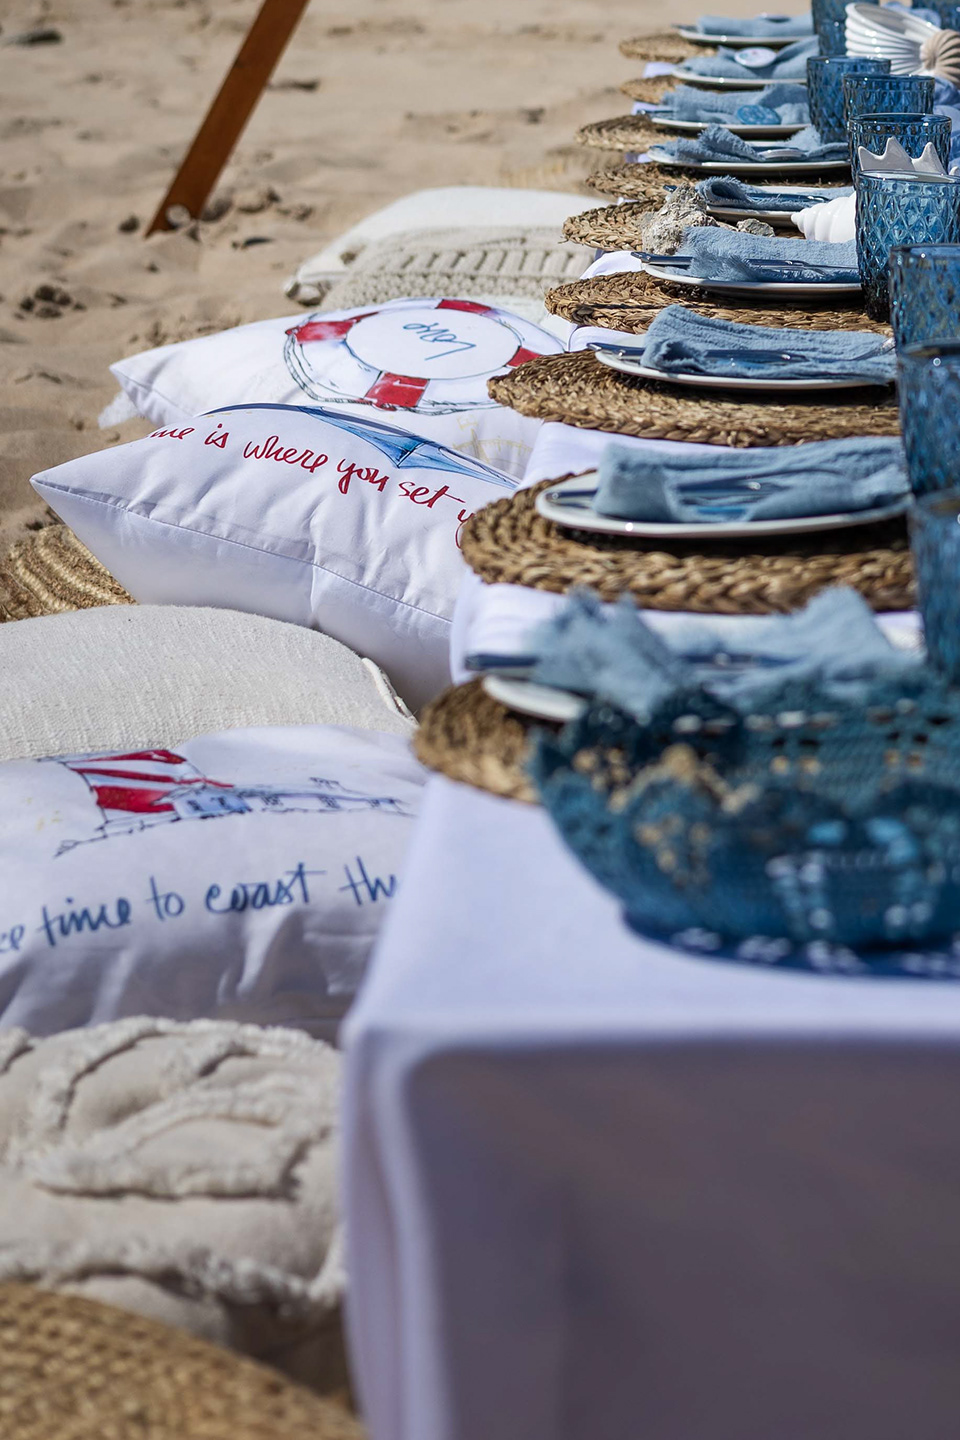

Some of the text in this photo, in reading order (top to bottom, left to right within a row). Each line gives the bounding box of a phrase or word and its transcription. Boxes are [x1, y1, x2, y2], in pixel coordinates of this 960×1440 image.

[150, 423, 475, 549] me is where you set y
[36, 896, 132, 948] time
[145, 875, 186, 922] to
[205, 862, 327, 914] coast
